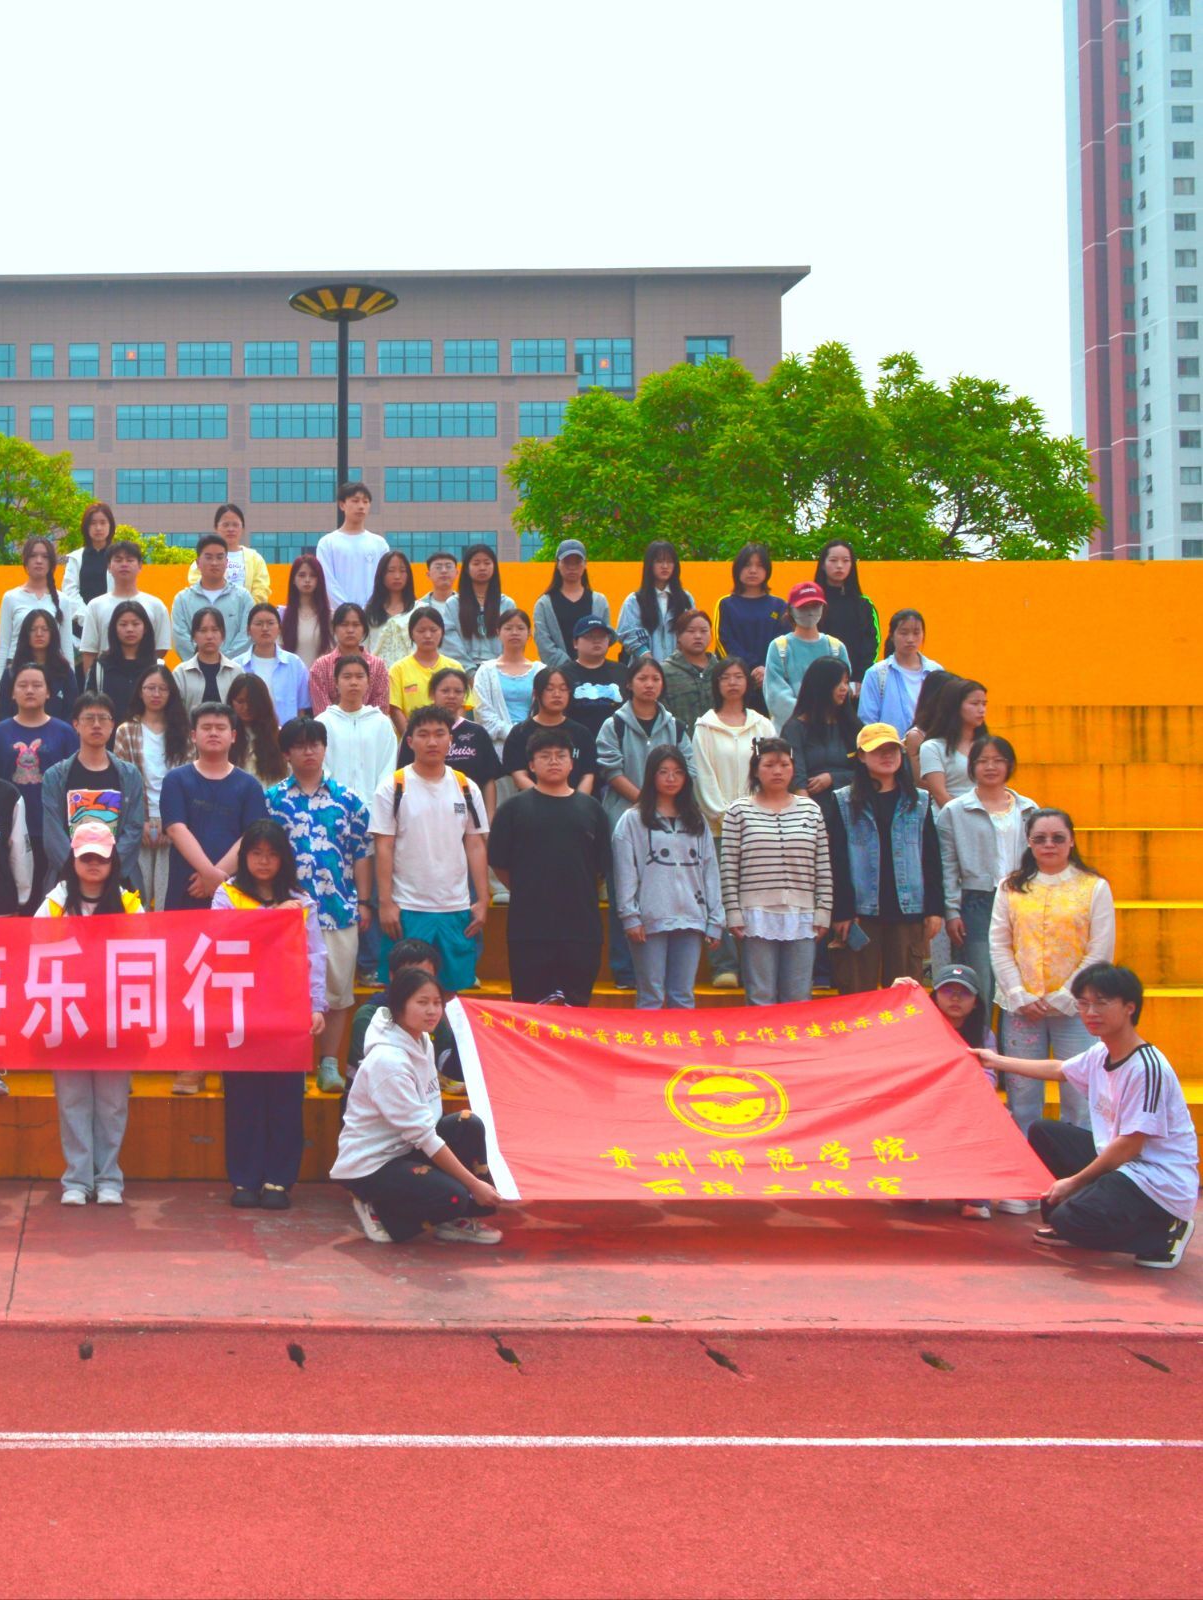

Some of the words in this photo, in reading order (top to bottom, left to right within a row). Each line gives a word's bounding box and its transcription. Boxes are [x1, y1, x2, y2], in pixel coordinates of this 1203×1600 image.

[599, 1135, 920, 1175] 贵州师范学院
